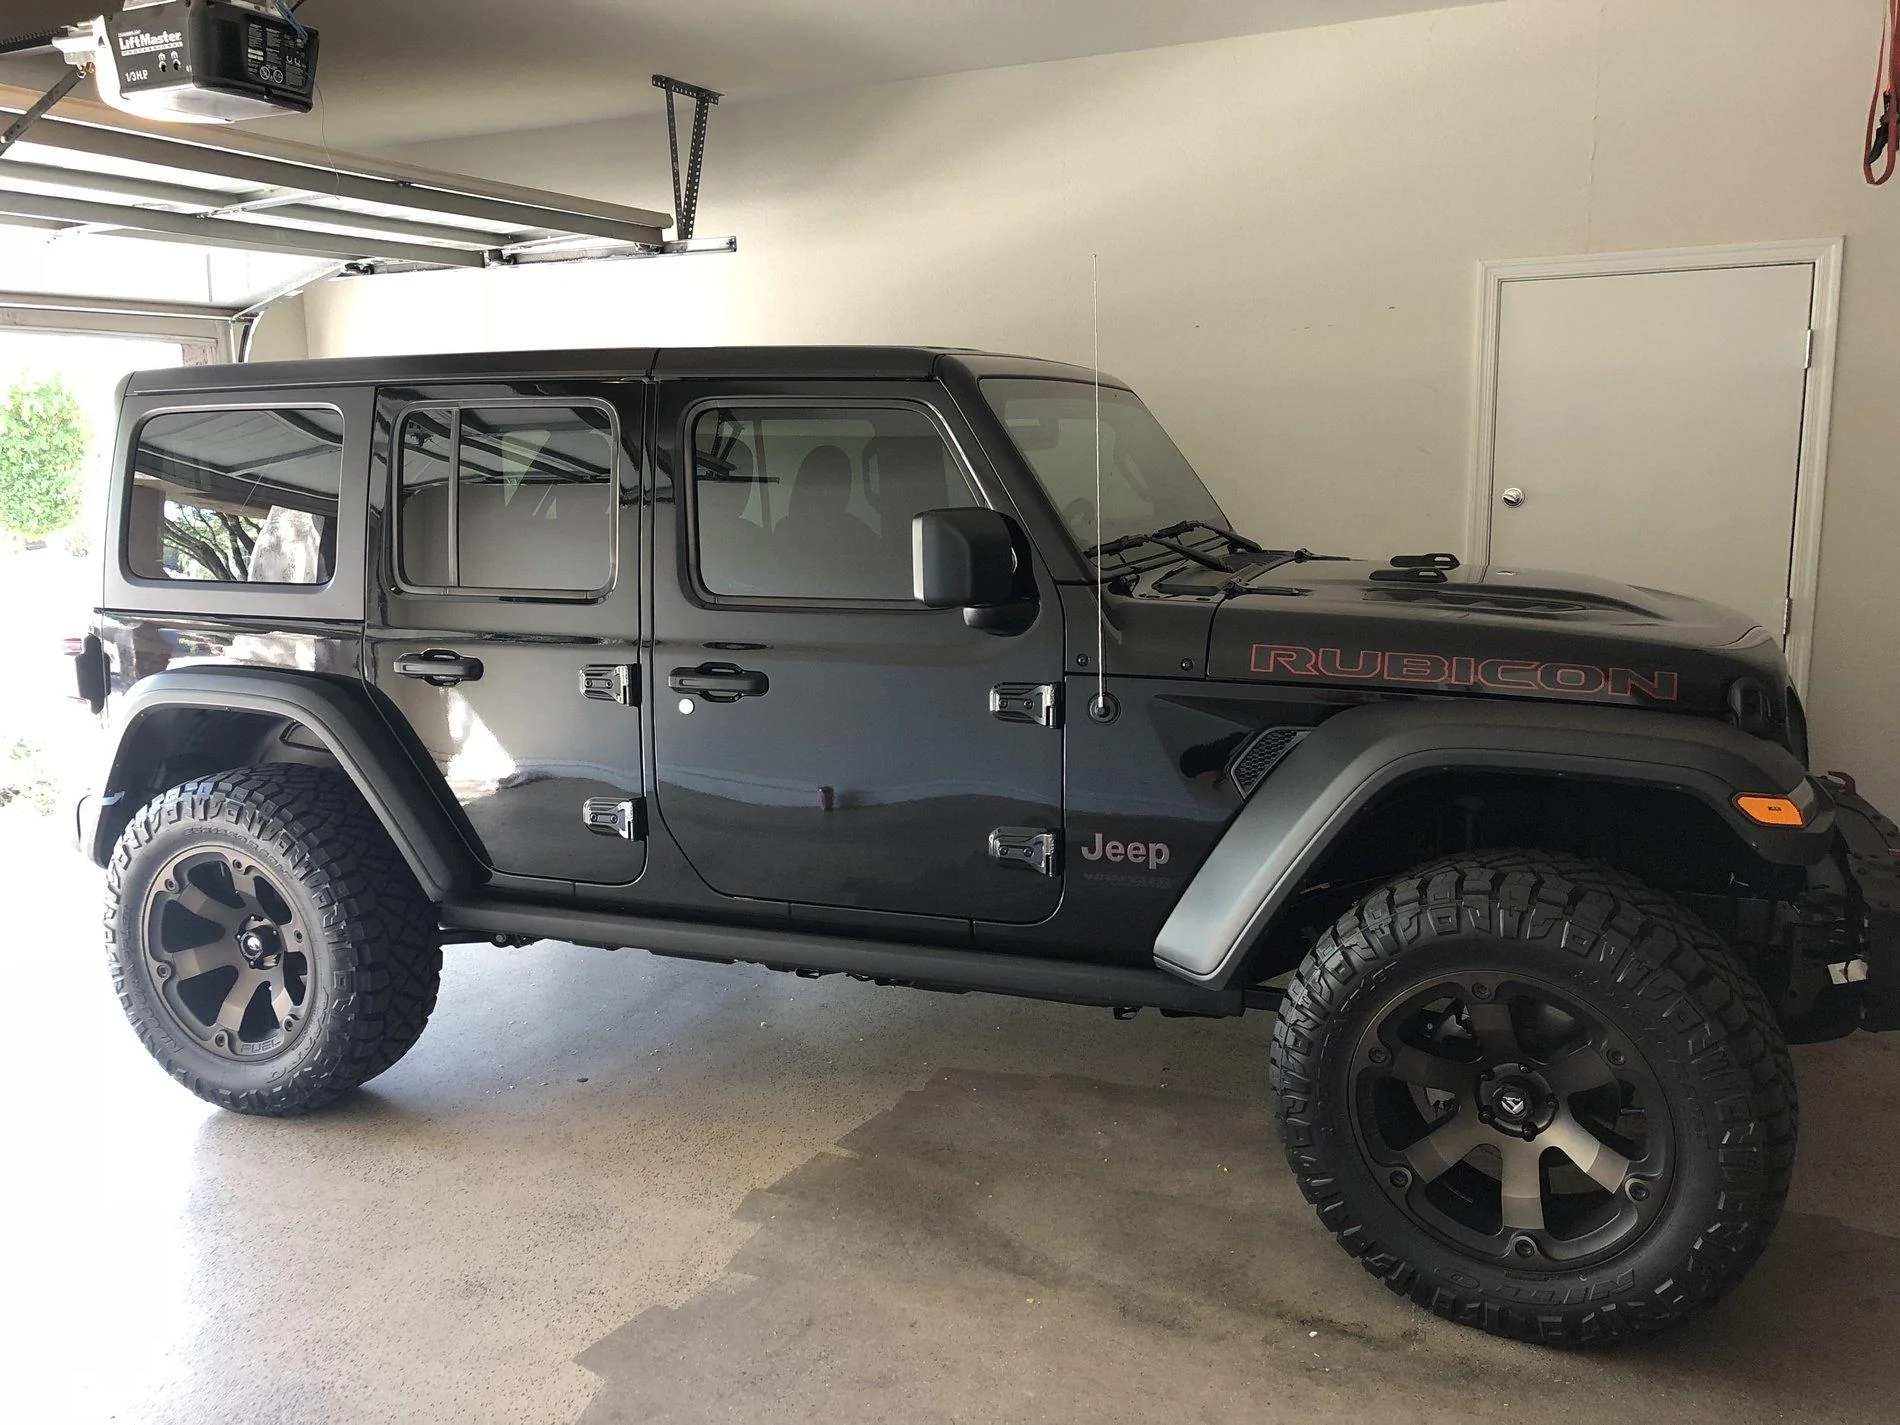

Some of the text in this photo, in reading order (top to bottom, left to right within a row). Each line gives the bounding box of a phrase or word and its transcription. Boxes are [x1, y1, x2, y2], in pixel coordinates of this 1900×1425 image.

[118, 30, 182, 50] LiftMaster
[1249, 643, 1679, 701] RUBICON
[1080, 832, 1171, 870] Jeep
[240, 1039, 282, 1054] FUEL
